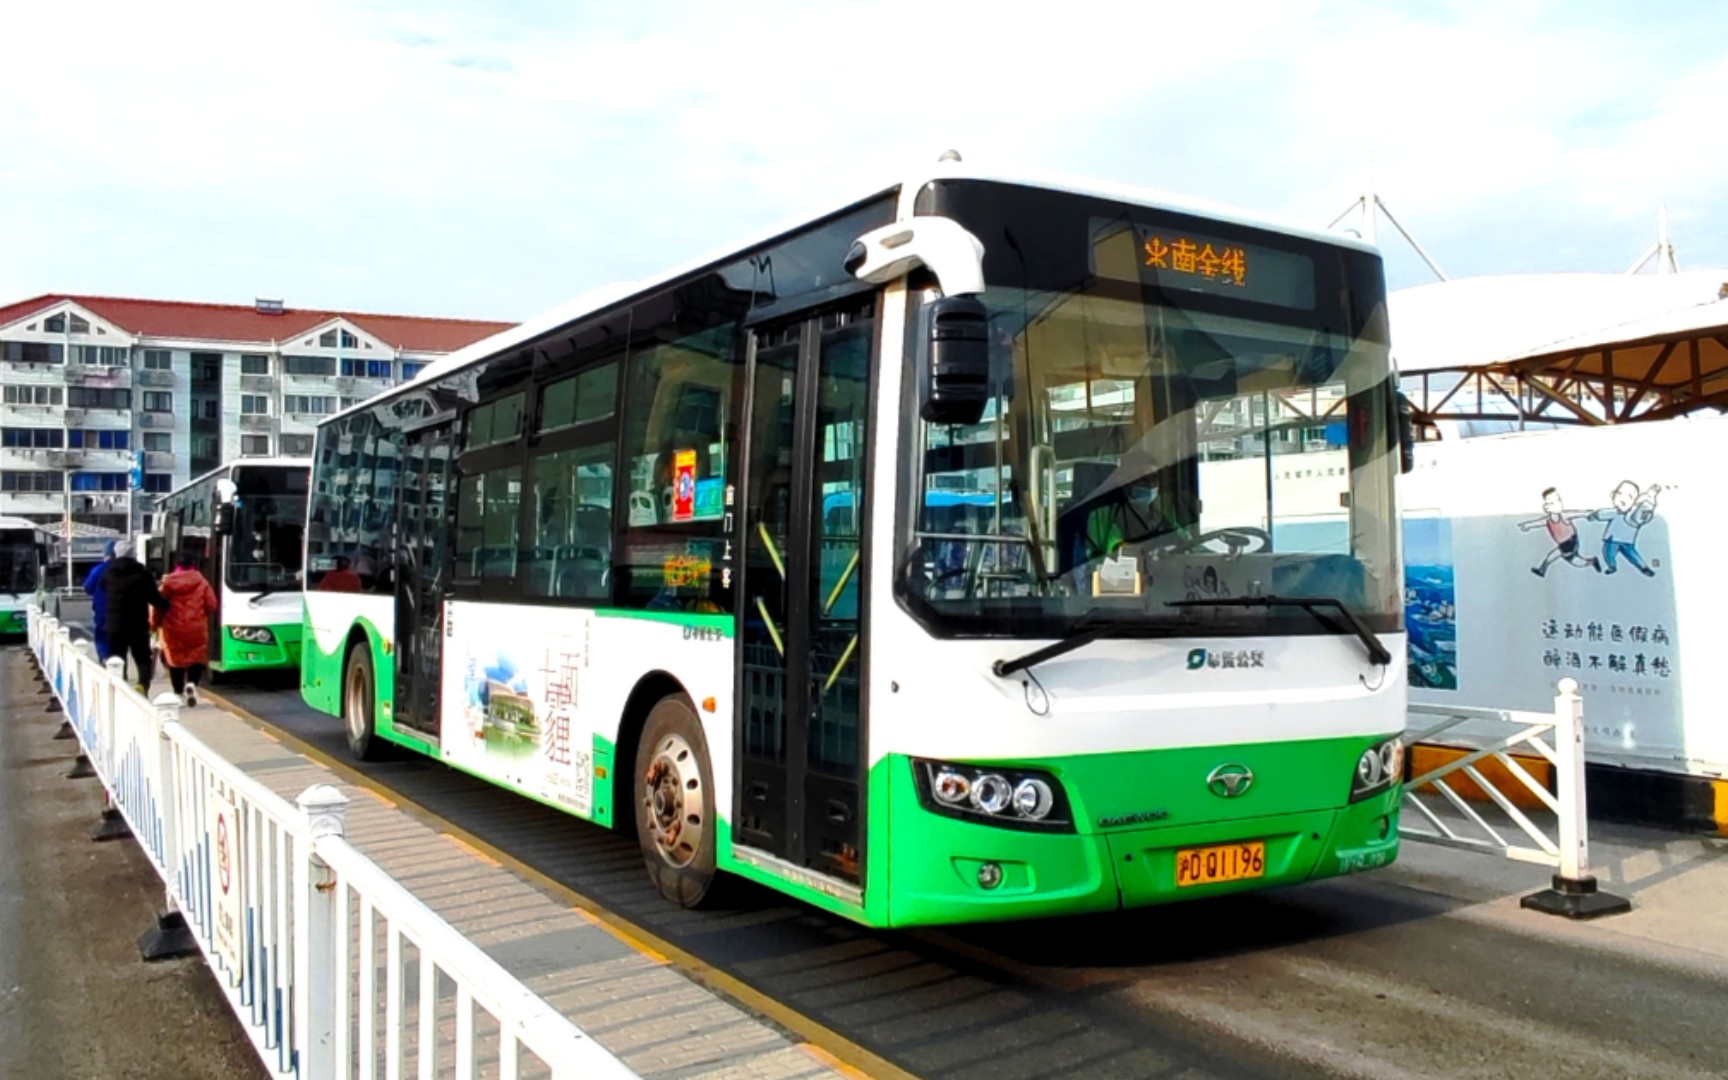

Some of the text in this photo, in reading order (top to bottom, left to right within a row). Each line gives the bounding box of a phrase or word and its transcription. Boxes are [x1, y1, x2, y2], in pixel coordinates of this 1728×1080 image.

[1542, 619, 1670, 646] 运动能医假病
[1543, 648, 1672, 678] 醉酒不解真愁
